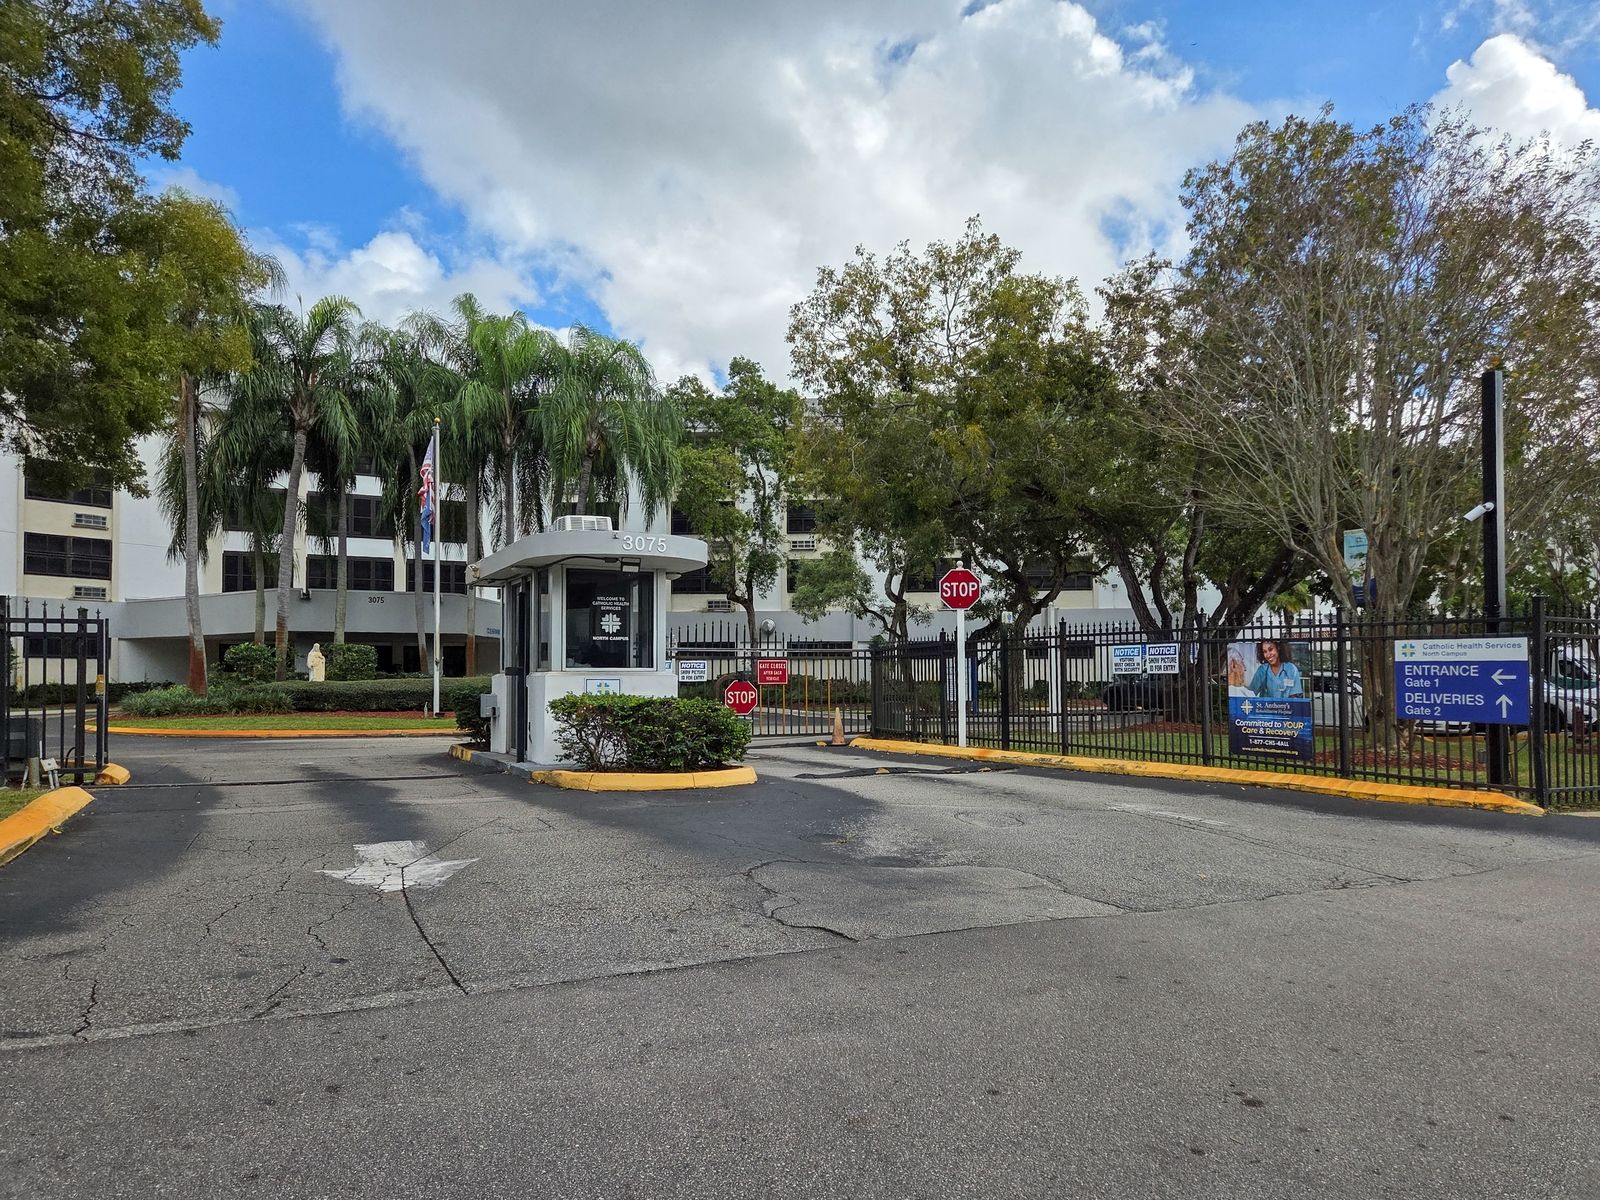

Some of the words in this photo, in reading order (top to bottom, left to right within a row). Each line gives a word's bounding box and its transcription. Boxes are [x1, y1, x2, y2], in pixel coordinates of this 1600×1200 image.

[623, 536, 666, 552] 3075
[942, 582, 978, 597] STOP
[1457, 642, 1483, 650] Health
[1114, 648, 1139, 656] NOTICE
[1404, 665, 1479, 676] ENTRANCE
[1404, 678, 1431, 688] Gate
[1434, 679, 1440, 687] 1
[727, 692, 756, 704] STOP
[1405, 692, 1484, 706] DELIVERIES
[1264, 702, 1290, 710] Anthony's
[1405, 705, 1431, 716] Gate
[1434, 706, 1441, 716] 2
[1235, 719, 1273, 727] Committed
[1283, 721, 1304, 729] YOUR
[1266, 728, 1298, 738] Recovery
